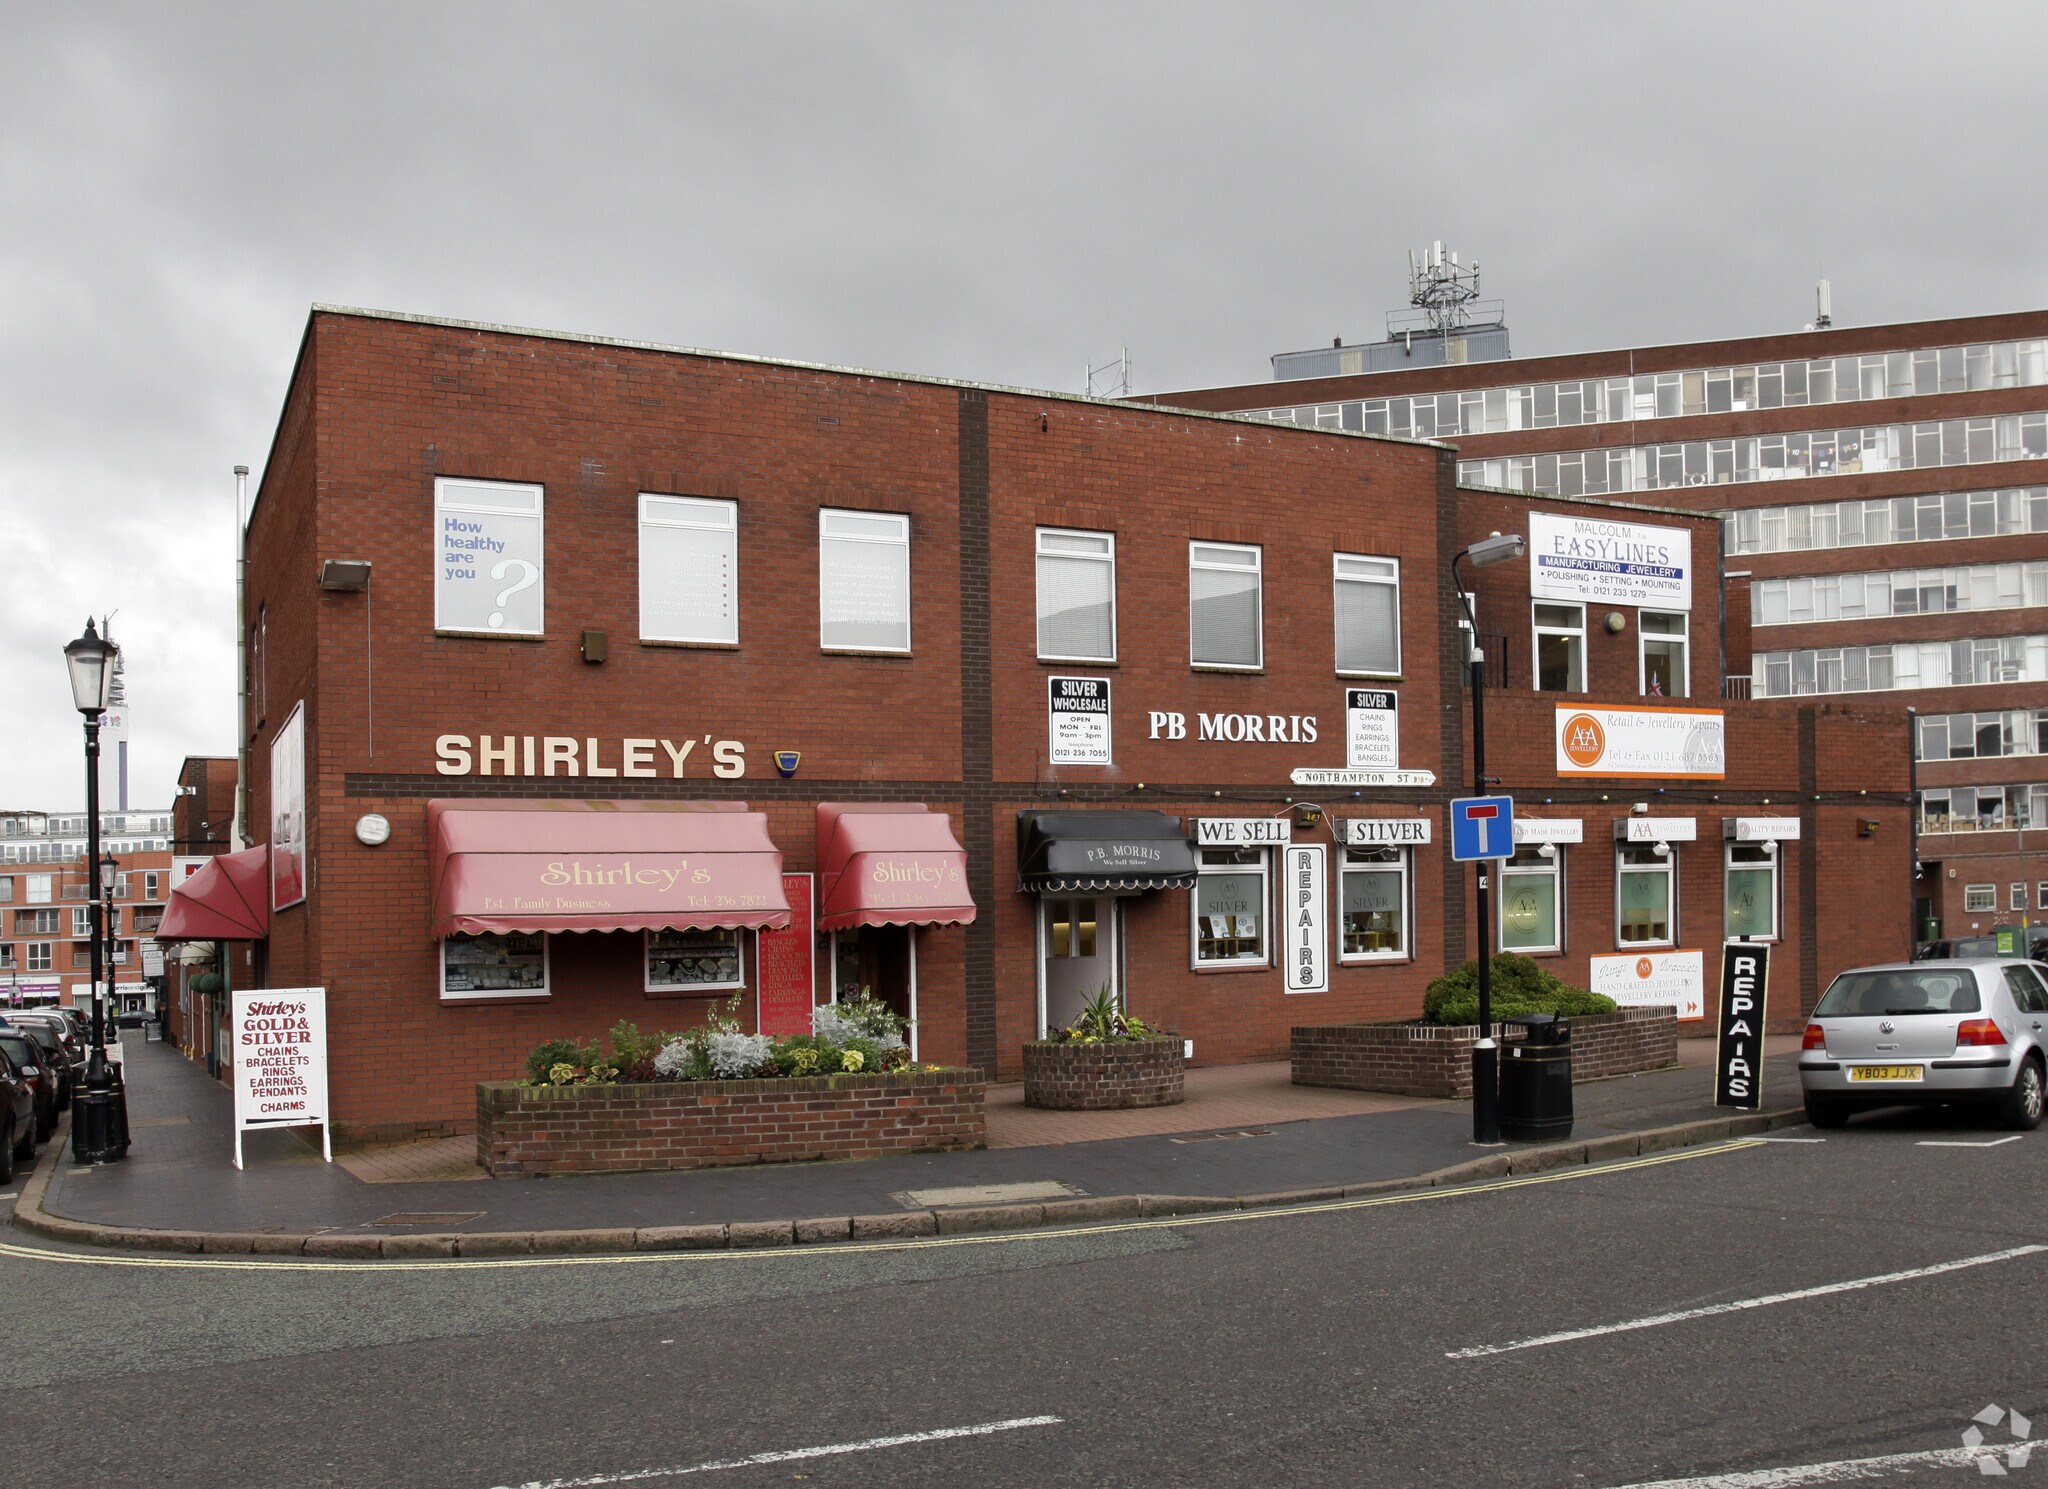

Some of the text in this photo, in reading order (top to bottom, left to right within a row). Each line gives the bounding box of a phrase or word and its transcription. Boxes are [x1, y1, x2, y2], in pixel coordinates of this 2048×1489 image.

[444, 517, 483, 534] How
[1574, 521, 1632, 539] MALCOLM
[444, 534, 505, 554] healthy
[1553, 535, 1669, 565] EASYLINES
[444, 552, 475, 564] are
[444, 567, 476, 581] you
[1545, 556, 1677, 578] MANUFACTURING JEWELLERY
[1547, 570, 1681, 591] POLISHING SETTING MOUNTING
[1577, 585, 1647, 599] Tel: 0121 233 1279
[1061, 680, 1098, 697] SILVER
[1053, 697, 1107, 711] WHOLESALE
[1357, 693, 1387, 708] SILVER
[1359, 713, 1386, 722] CHAINS
[1607, 714, 1721, 734] Retail & Jewellery Repairs
[1148, 711, 1318, 744] PB MORRIS
[1361, 723, 1383, 732] RINGS
[1059, 731, 1077, 739] 9am
[1084, 732, 1102, 740] 3pm
[1355, 733, 1390, 742] EARRINGS
[1570, 724, 1599, 746] A&A
[1054, 748, 1108, 758] 0121 236 7055
[1354, 743, 1391, 752] BRACELETS
[1569, 745, 1599, 753] JEWELLERY
[435, 734, 745, 779] SHIRLEY'S
[1357, 753, 1388, 762] BANGLES
[1607, 749, 1621, 760] Tel
[1635, 750, 1652, 761] Fax
[1653, 751, 1675, 761] 0121
[1304, 772, 1386, 784] NORTHAMPTON
[1397, 774, 1410, 783] ST
[1200, 822, 1289, 841] WE SELL
[1356, 822, 1426, 841] SILVER
[1633, 821, 1692, 838] A&A JEWELLERY
[1770, 824, 1797, 833] REPAIRS
[1086, 844, 1161, 861] P.B. MORRIS
[540, 859, 712, 893] Shirley's
[872, 859, 960, 890] Shirley's
[783, 878, 809, 889] LEY'S
[484, 896, 611, 913] Est. Family Business
[687, 894, 768, 907] Tel: 236 7822
[1208, 900, 1249, 913] SILVER
[1352, 896, 1390, 909] SILVER
[1298, 851, 1313, 985] REPAIRS
[1659, 957, 1699, 974] Bracelets
[1600, 978, 1694, 992] HAND CRAFTED JEWELLERY
[1614, 989, 1682, 1002] JEWELLERY REPAIRS
[246, 1000, 307, 1017] Shirley's
[1728, 956, 1757, 1097] REPAIRS
[241, 1031, 312, 1046] SILVER
[257, 1046, 299, 1057] CHAINS
[245, 1055, 310, 1068] BRACELETS
[262, 1066, 296, 1077] RINGS
[1857, 1067, 1917, 1080] YB03 JJX
[249, 1076, 304, 1088] EARRINGS
[252, 1085, 308, 1098] PENDANTS
[260, 1100, 306, 1113] CHARMS
